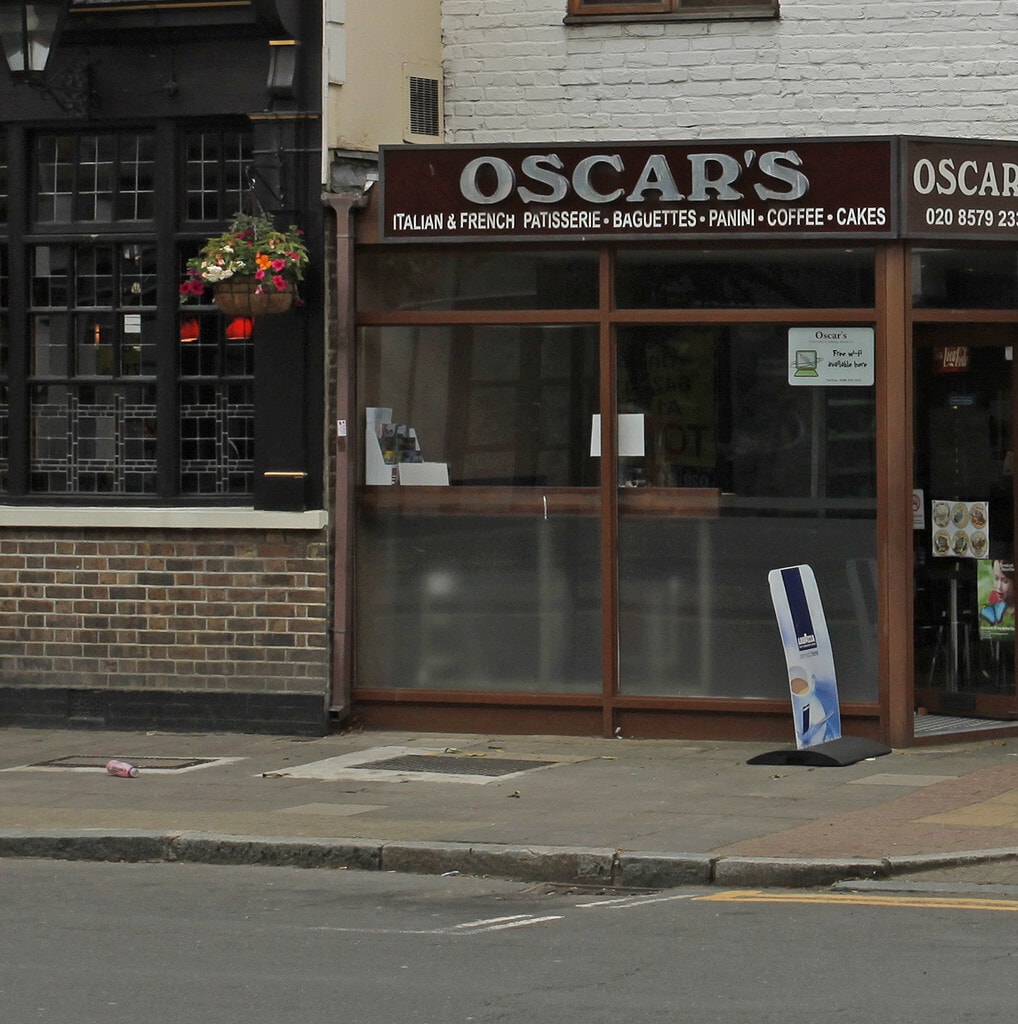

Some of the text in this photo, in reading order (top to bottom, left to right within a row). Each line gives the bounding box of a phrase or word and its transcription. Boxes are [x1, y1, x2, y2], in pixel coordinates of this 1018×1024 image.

[459, 150, 809, 204] OSCAR'S
[393, 207, 887, 230] ITALIAN & FRENCH PATISSERIE BAGUETTES PANINI COFFEE CAKES
[926, 208, 953, 225] 020
[958, 209, 993, 226] 8579
[815, 331, 848, 339] Oscar's
[832, 349, 846, 357] Free
[827, 360, 852, 368] available
